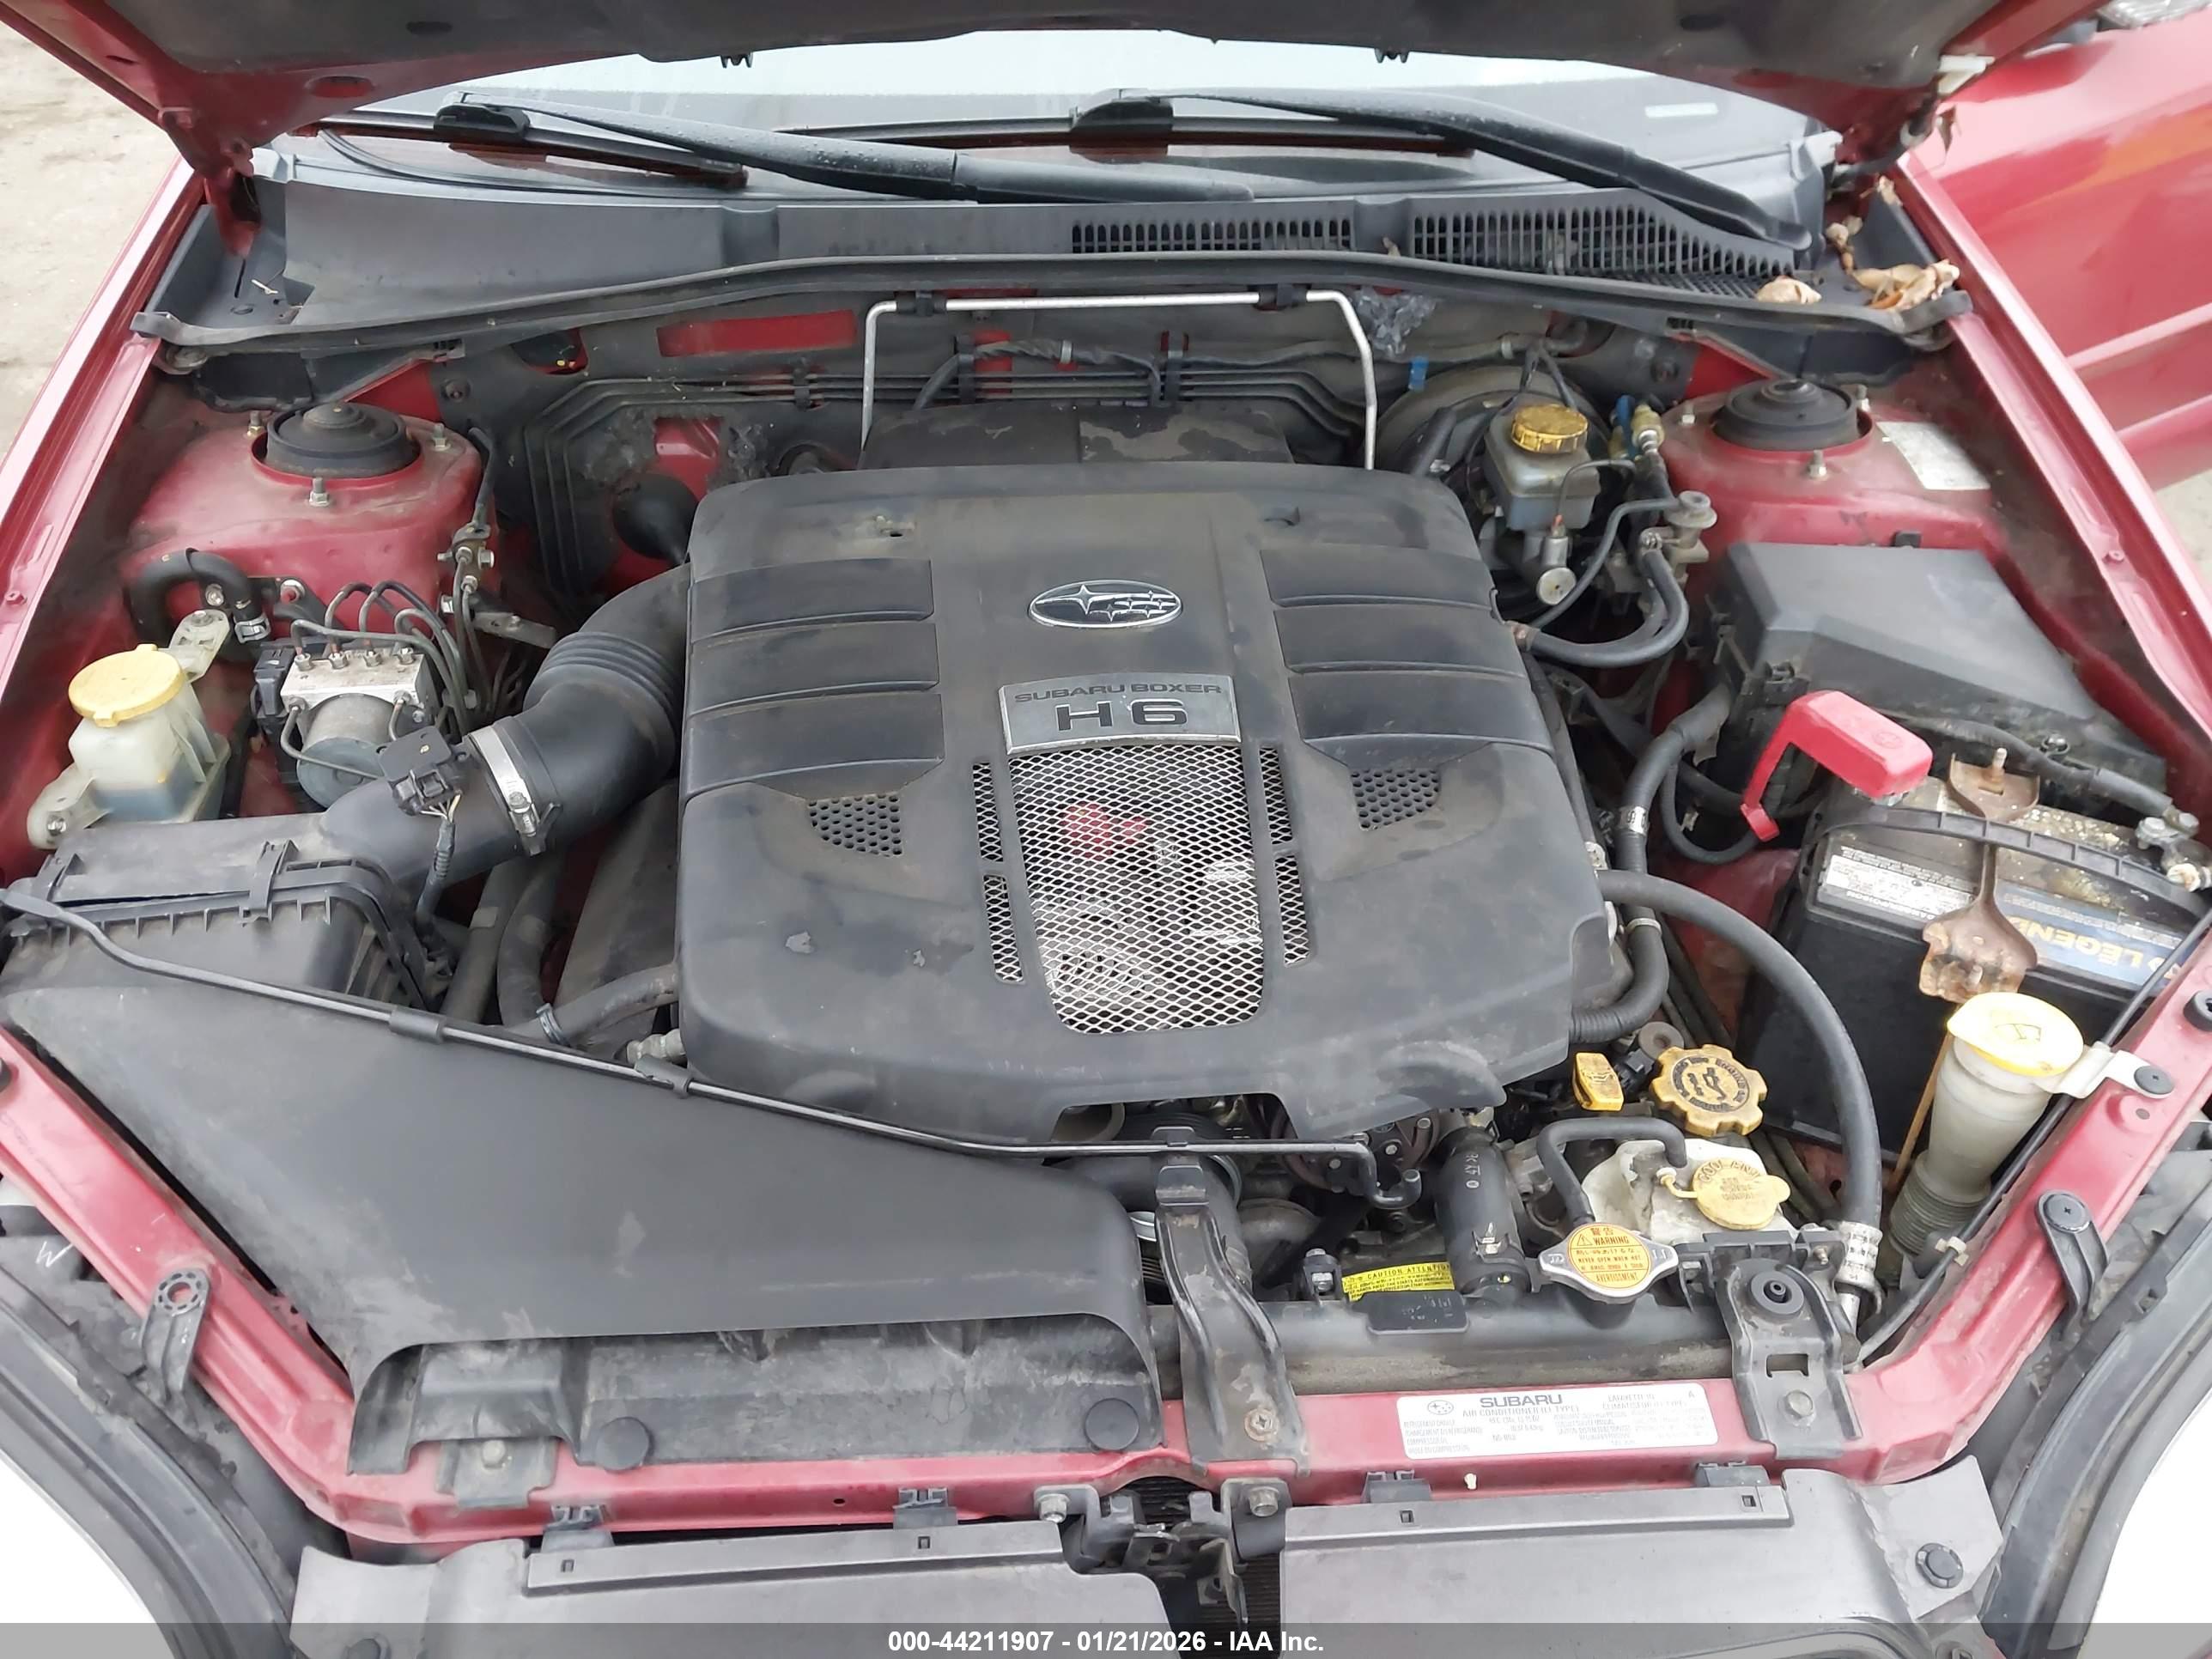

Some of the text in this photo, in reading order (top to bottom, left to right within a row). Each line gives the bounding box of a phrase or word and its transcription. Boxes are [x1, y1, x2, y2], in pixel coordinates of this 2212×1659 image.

[1015, 683, 1223, 703] SUBARU BOXER
[1593, 1236, 1630, 1246] WARNING
[1367, 1268, 1402, 1279] CAUTION
[1480, 1394, 1563, 1409] SUBARU
[1462, 1409, 1477, 1418] AIR
[1479, 1407, 1539, 1417] CONDITIONER
